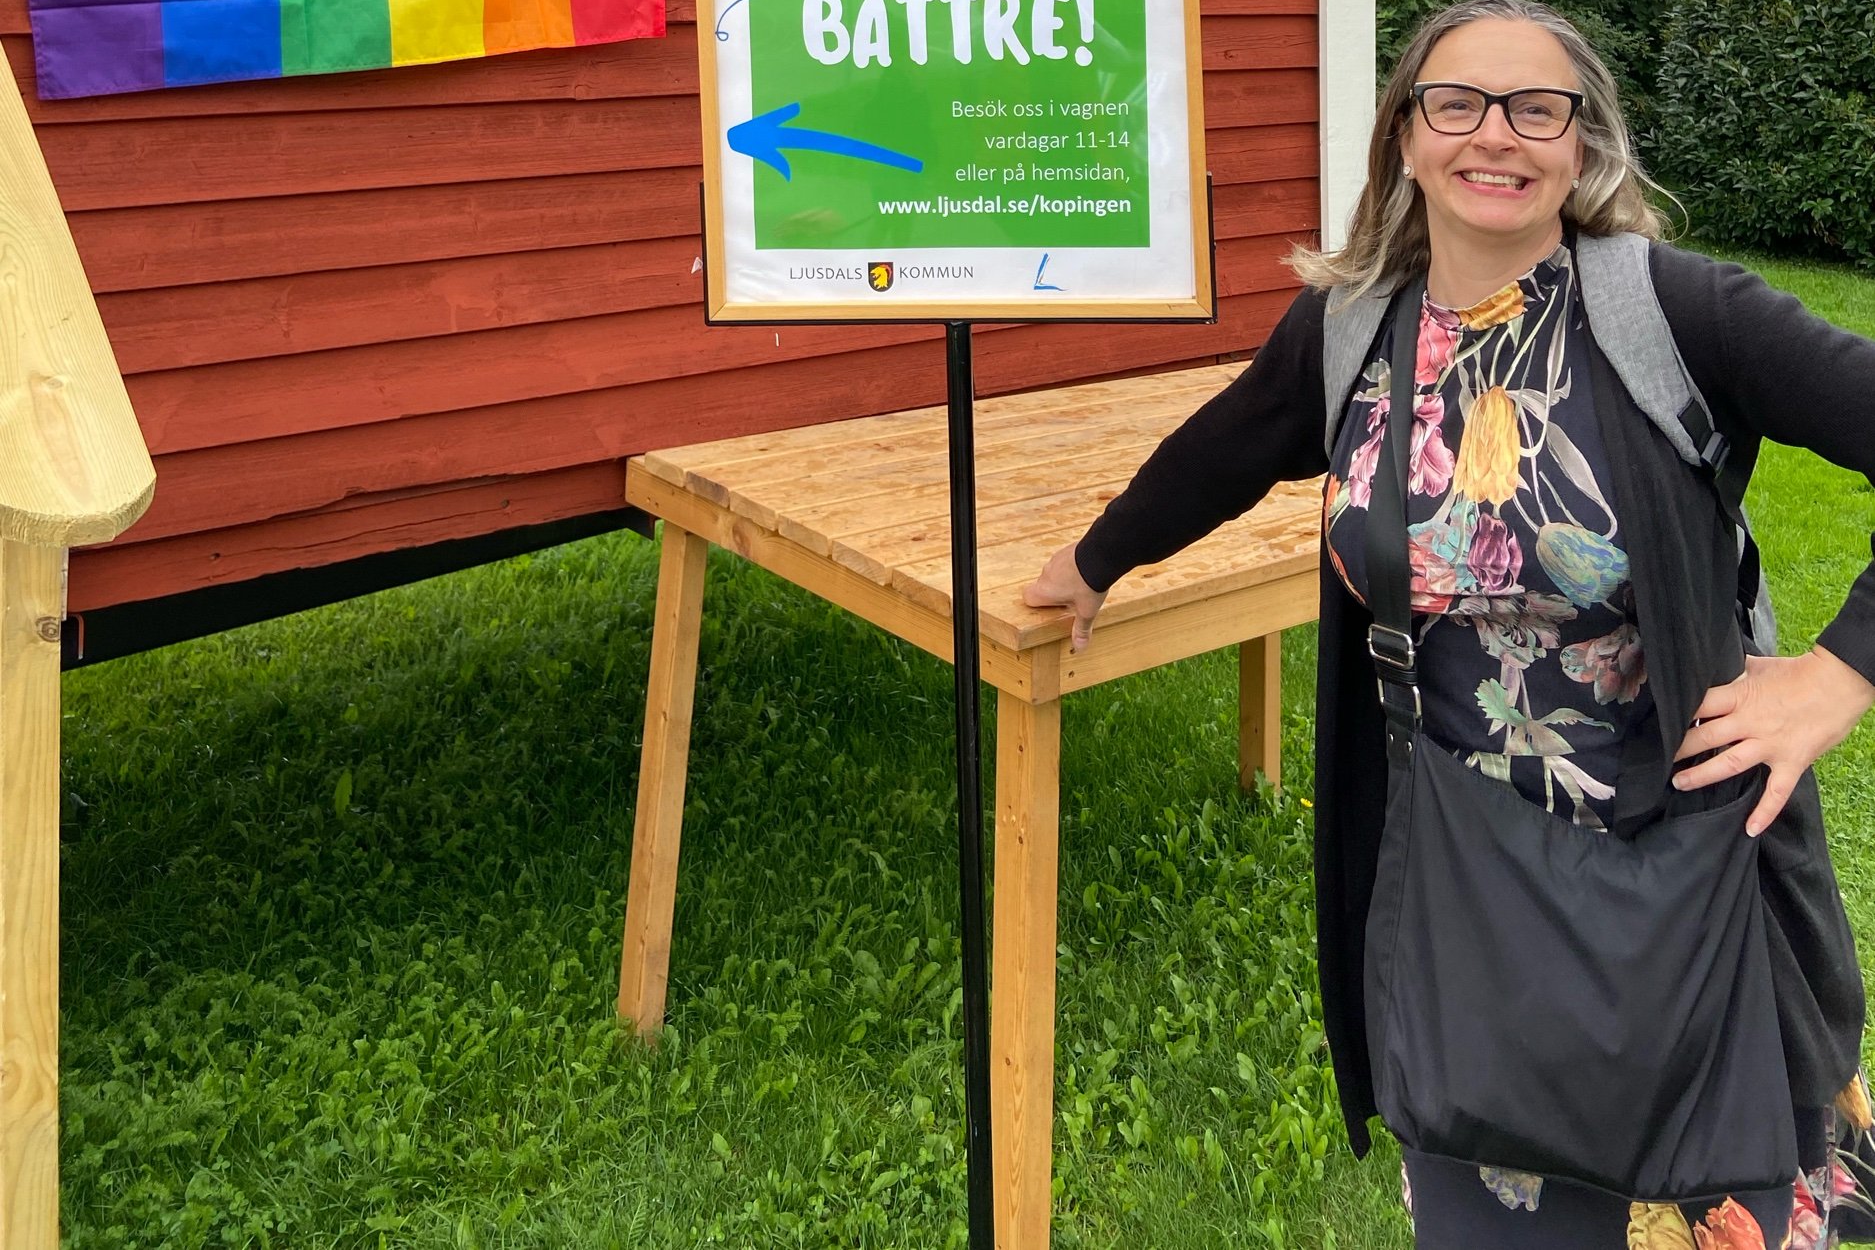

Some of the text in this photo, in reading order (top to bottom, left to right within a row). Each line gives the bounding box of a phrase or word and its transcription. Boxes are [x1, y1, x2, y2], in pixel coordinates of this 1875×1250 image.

[951, 99, 1130, 120] Besök oss i vagnen
[984, 130, 1130, 153] vardagar 11-14
[955, 162, 1131, 185] eller på hemsidan,
[878, 194, 1132, 217] www.ljusdal.se/kopingen
[789, 265, 974, 280] LJUSDALS KOMMUN
